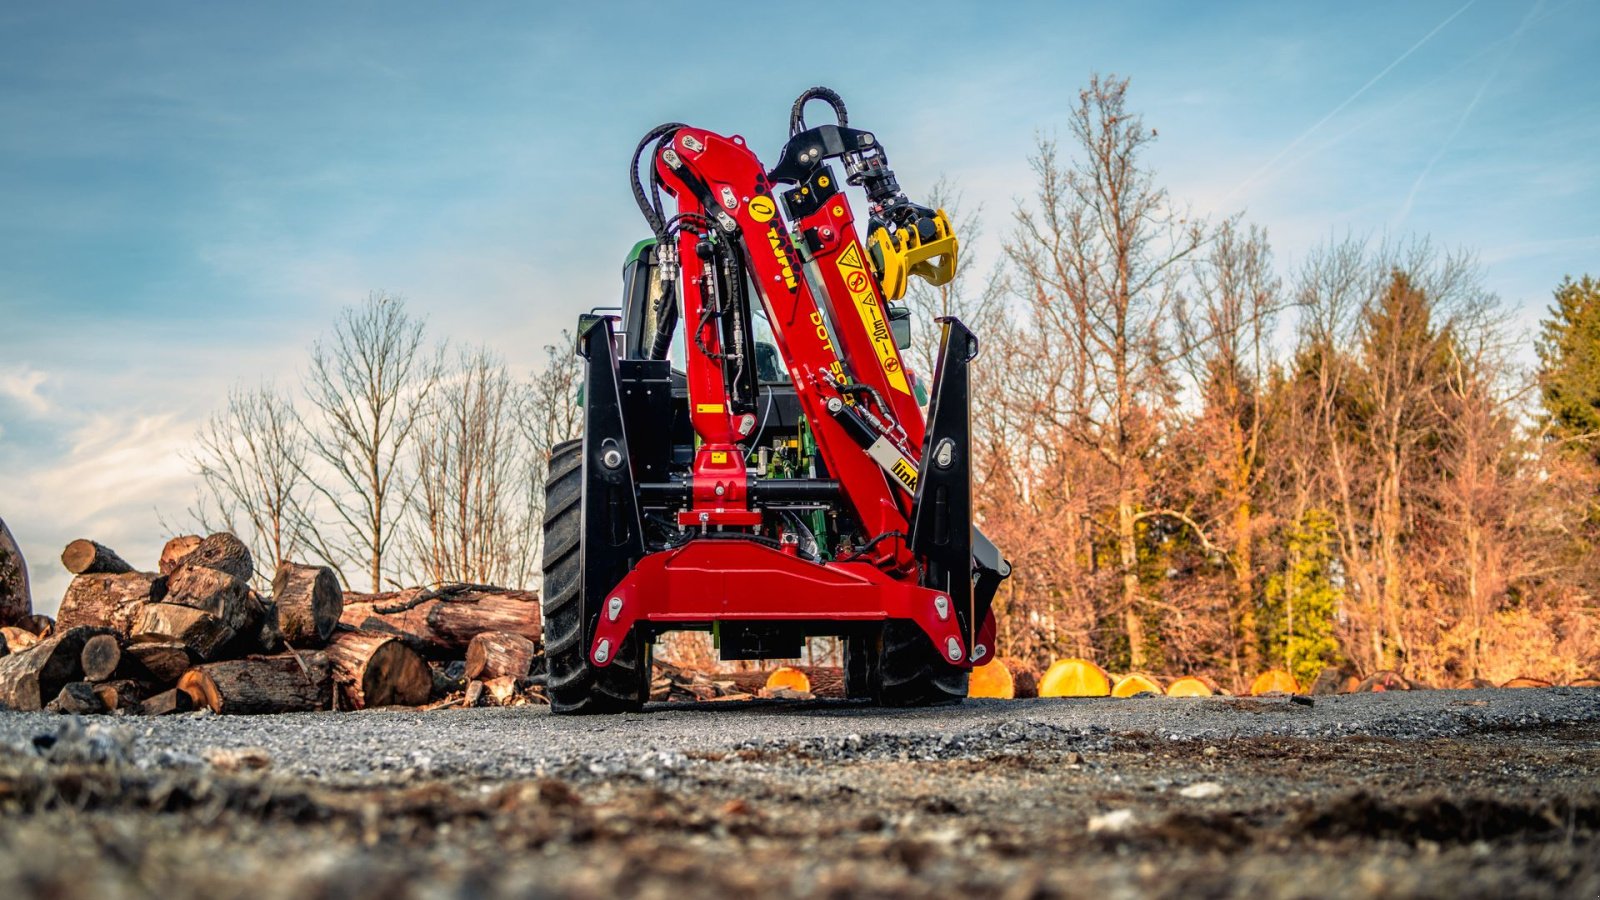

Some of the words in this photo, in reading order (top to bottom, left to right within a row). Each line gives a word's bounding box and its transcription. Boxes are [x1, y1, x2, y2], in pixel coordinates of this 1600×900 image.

[767, 227, 798, 289] TAJFUN
[810, 311, 835, 353] DOT
[873, 319, 888, 342] 20m
[892, 462, 917, 492] link
